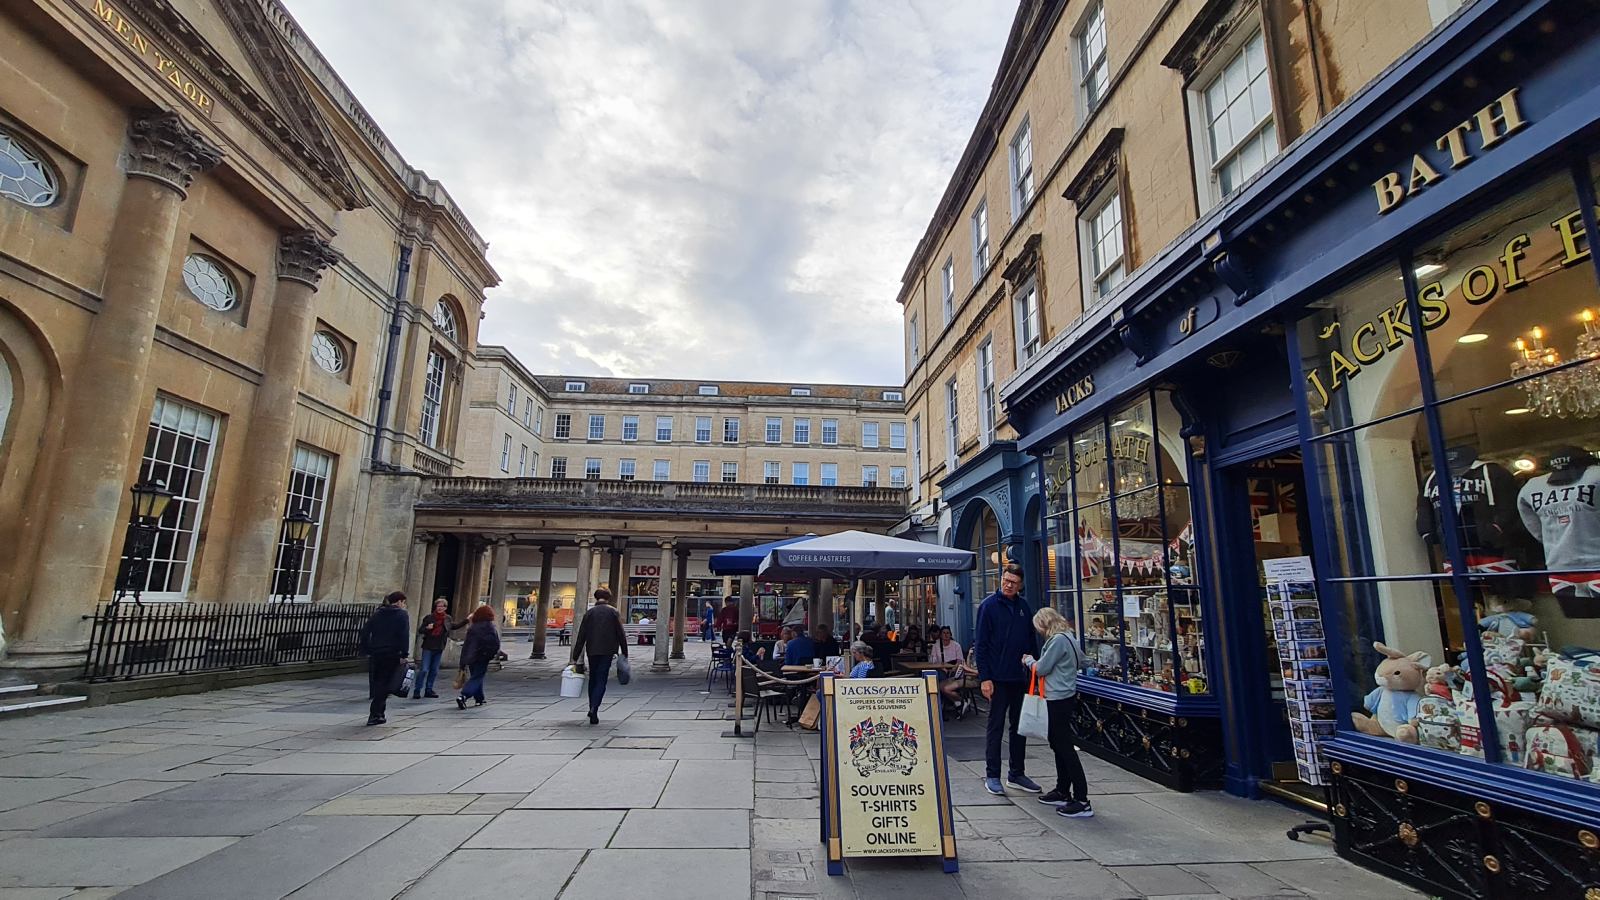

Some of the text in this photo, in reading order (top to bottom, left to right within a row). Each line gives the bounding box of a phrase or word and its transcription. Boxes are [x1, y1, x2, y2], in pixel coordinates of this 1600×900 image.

[1055, 87, 1528, 415] JACKS of BATH
[1307, 281, 1450, 408] JACKS
[1047, 451, 1081, 505] ACKS
[1531, 484, 1596, 512] BATH
[788, 554, 851, 563] COFFEE & PASTRIES
[841, 685, 879, 696] JACKS
[890, 685, 919, 695] BATH
[851, 784, 925, 797] SOUVENIRS
[861, 800, 917, 812] T-SHIRTS
[872, 816, 909, 828] GIFTS
[866, 832, 917, 845] ONLINE
